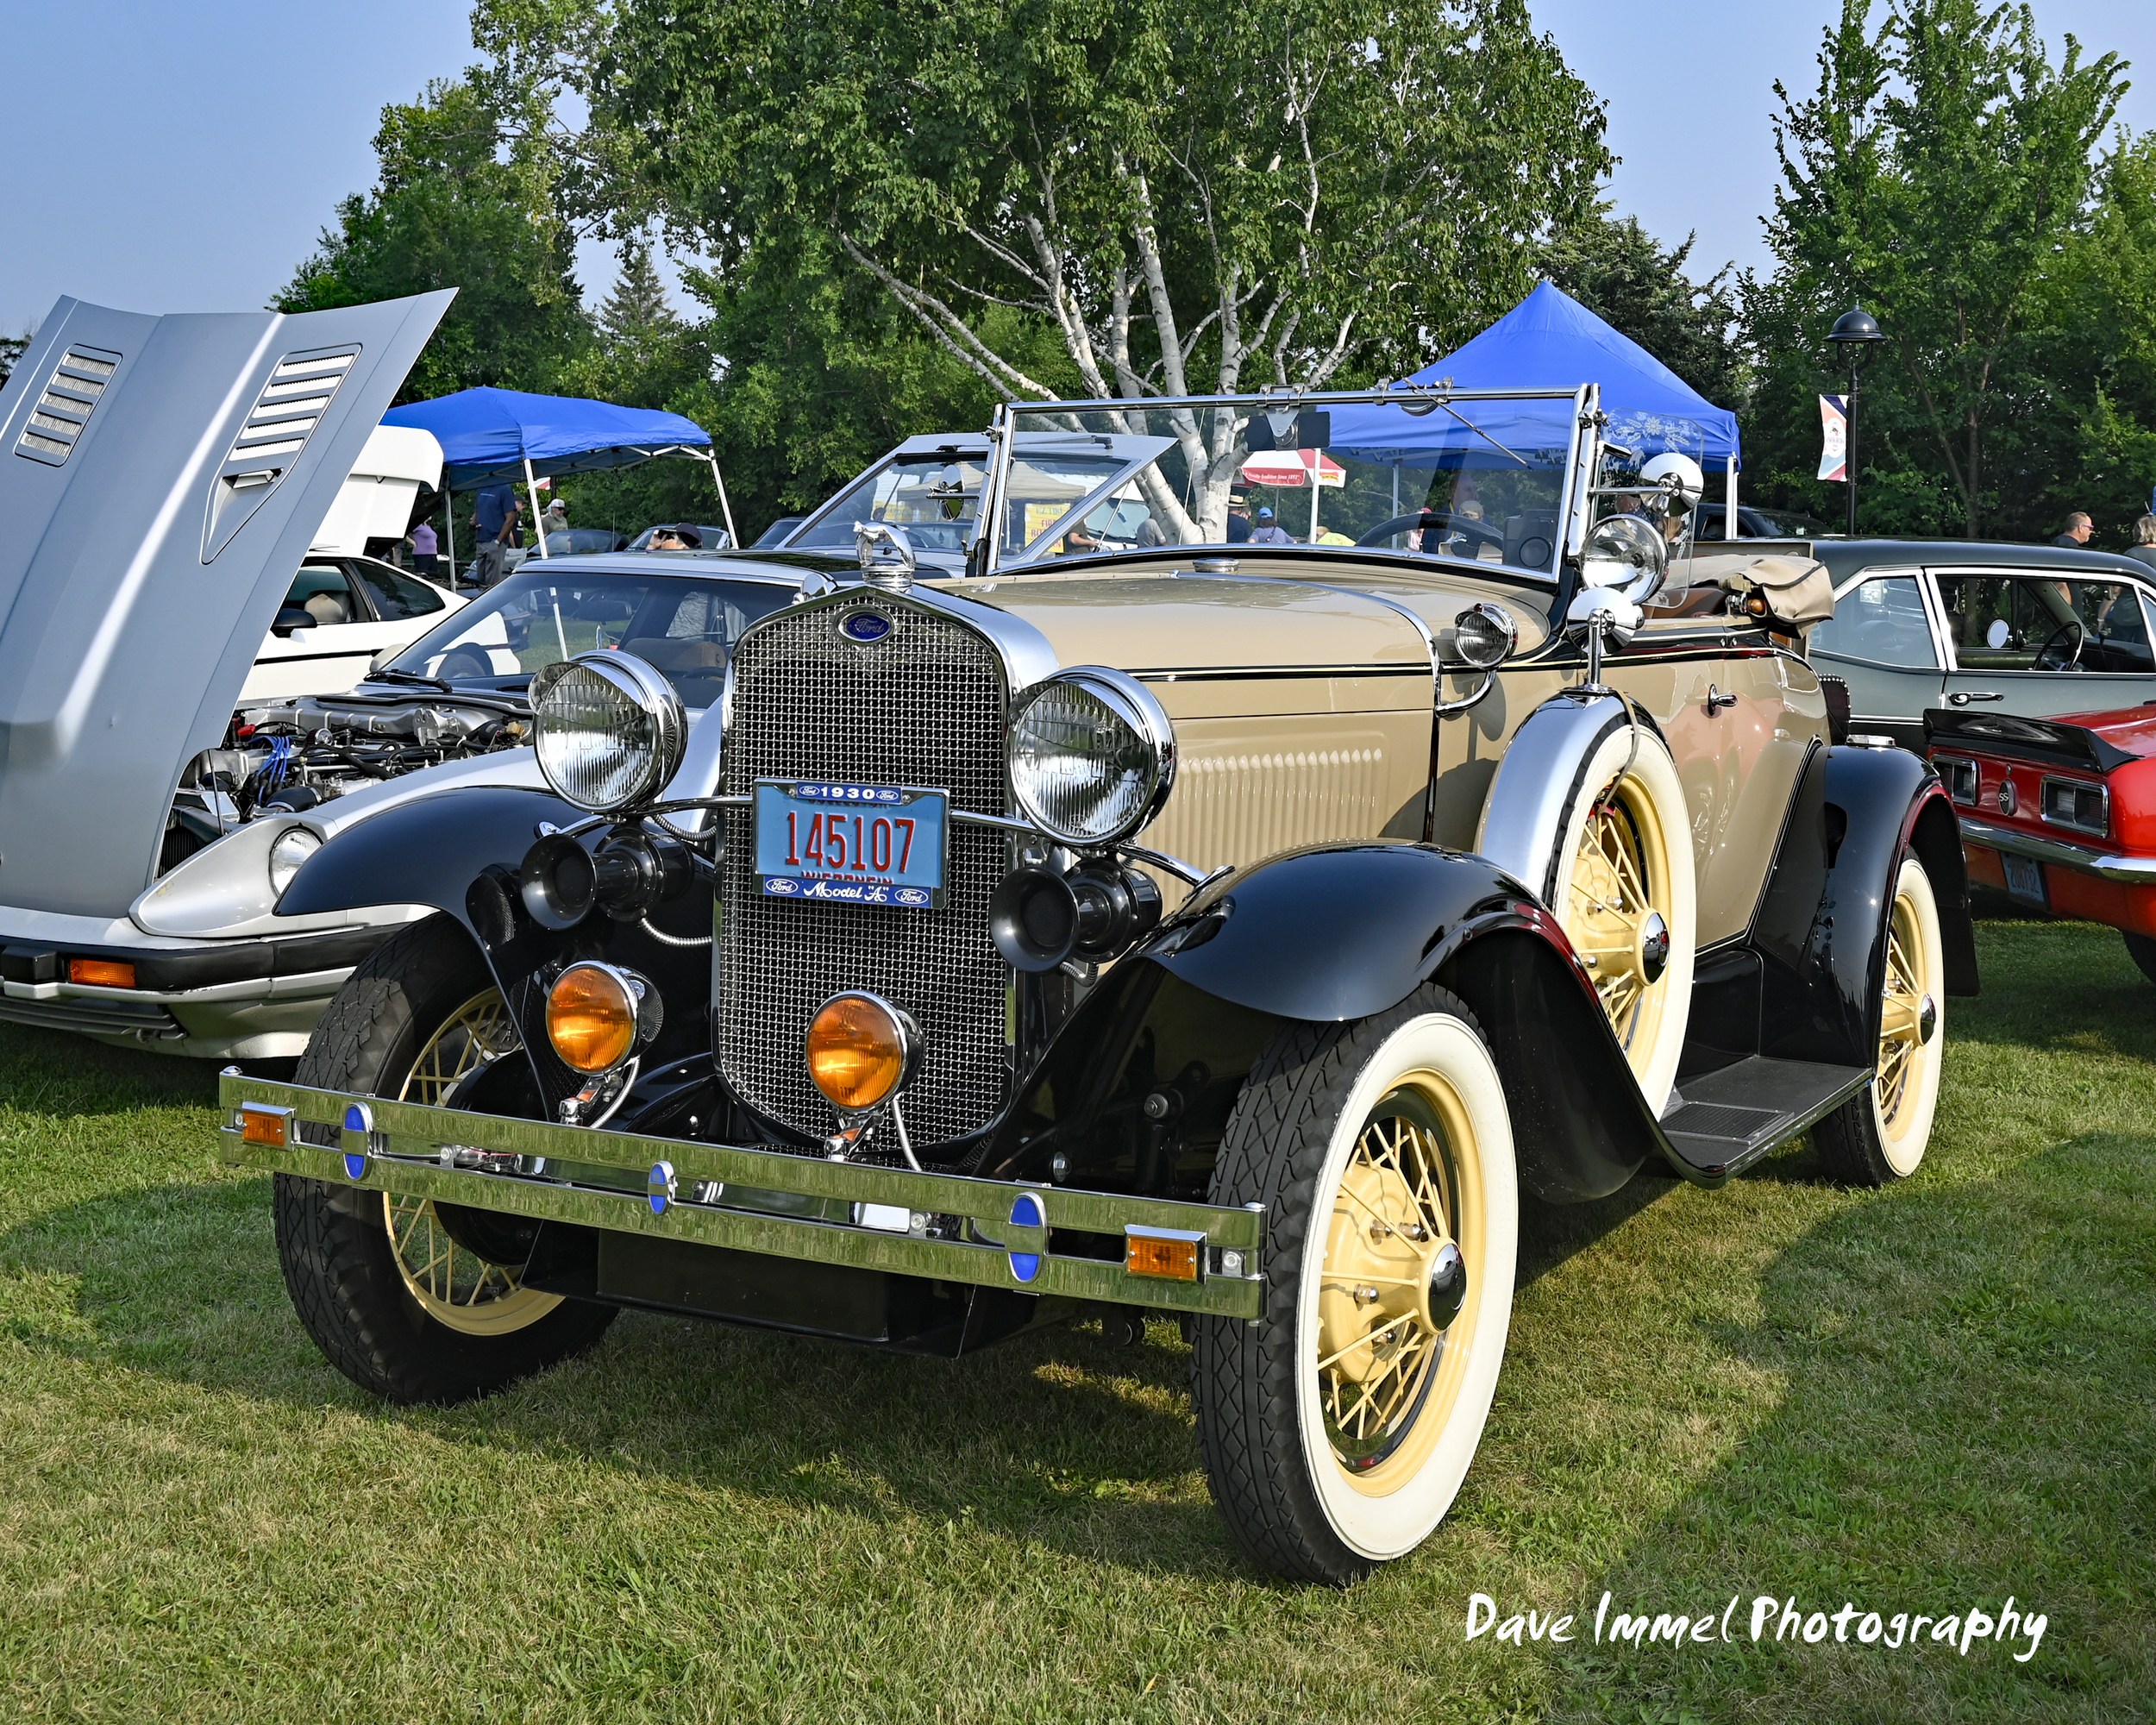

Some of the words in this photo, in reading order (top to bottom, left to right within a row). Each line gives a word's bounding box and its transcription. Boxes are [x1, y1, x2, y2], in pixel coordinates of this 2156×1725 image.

[854, 618, 885, 634] Ford
[800, 786, 817, 795] Ford
[820, 786, 876, 800] 1930
[879, 791, 896, 800] Ford
[1998, 792, 2009, 802] SS
[785, 811, 916, 874] 145107
[770, 880, 793, 893] Ford
[803, 881, 863, 899] Model
[899, 890, 924, 903] Ford
